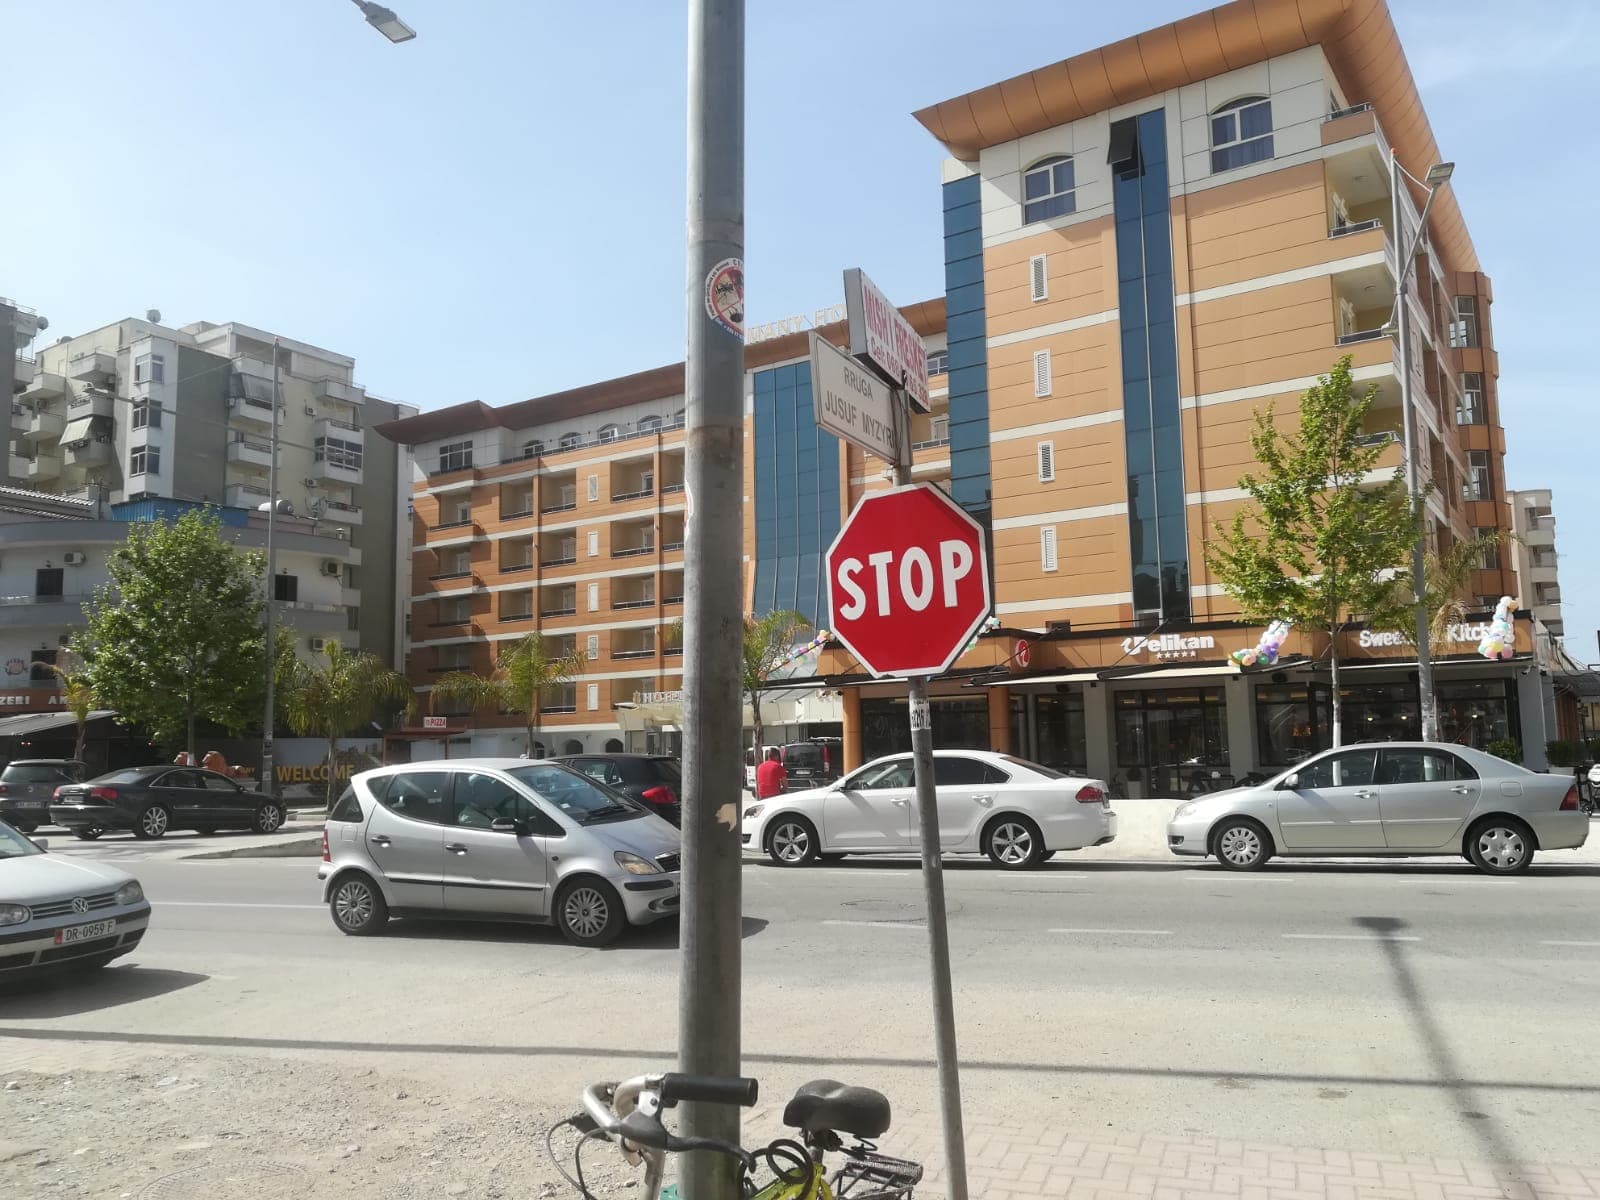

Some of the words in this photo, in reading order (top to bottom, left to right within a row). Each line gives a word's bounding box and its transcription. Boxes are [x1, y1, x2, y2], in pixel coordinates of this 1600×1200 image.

[843, 366, 874, 402] RRUGA
[825, 390, 857, 426] JUSUF
[837, 539, 974, 621] STOP
[1121, 634, 1215, 656] Pelikan
[277, 765, 354, 781] WELCOME
